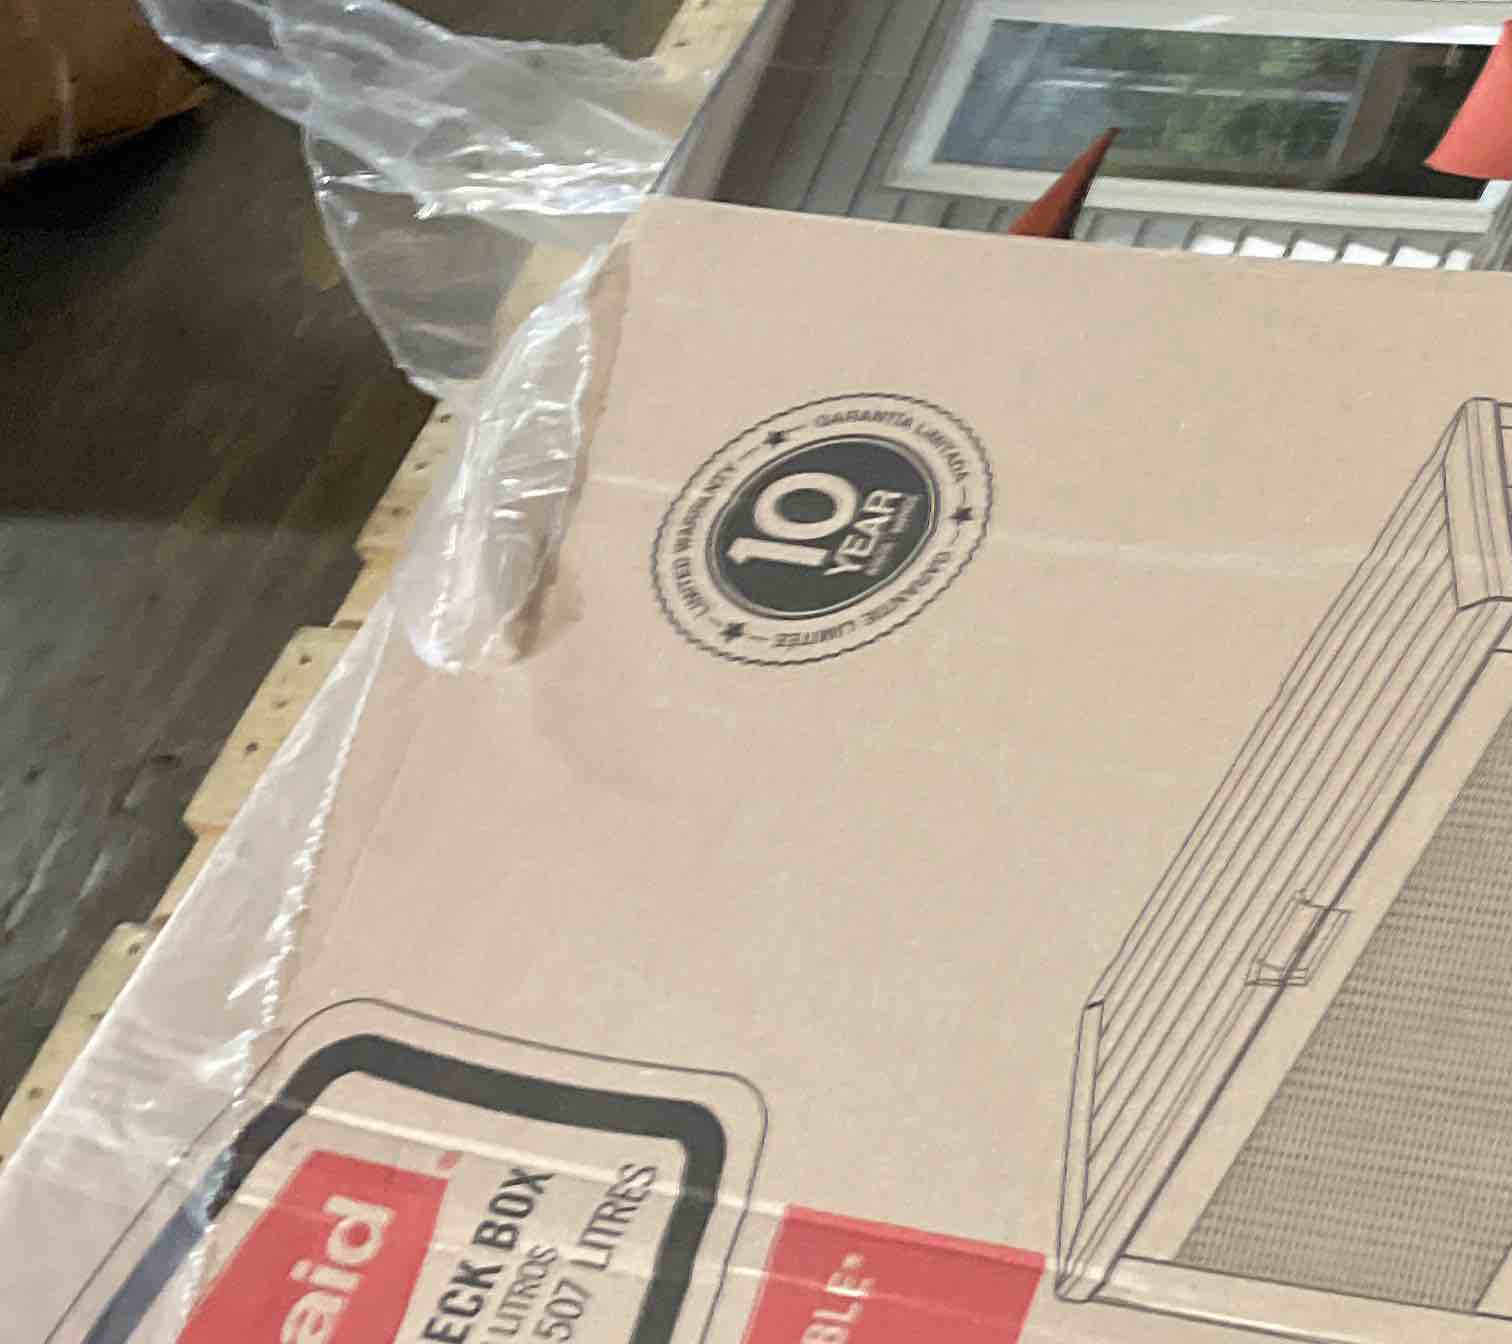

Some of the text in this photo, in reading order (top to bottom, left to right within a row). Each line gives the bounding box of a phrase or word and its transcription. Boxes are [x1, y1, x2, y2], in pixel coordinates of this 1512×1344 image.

[726, 471, 859, 567] 10
[822, 488, 912, 577] YEAR
[473, 1163, 558, 1259] BOX
[573, 1158, 660, 1275] LITRES
[487, 1243, 561, 1329] LITROS
